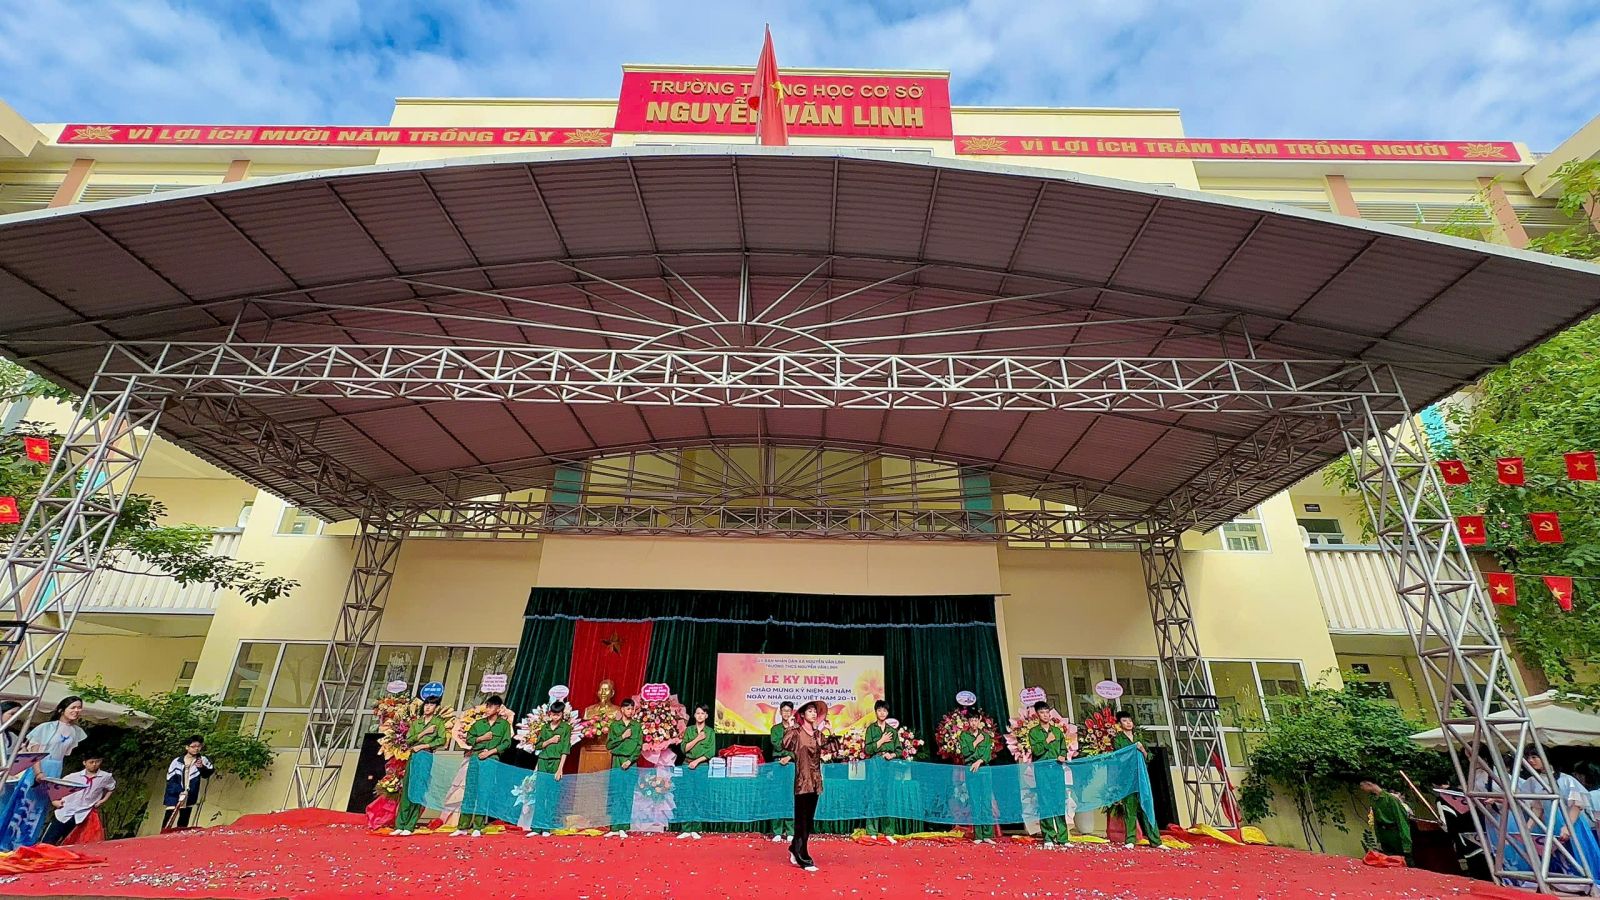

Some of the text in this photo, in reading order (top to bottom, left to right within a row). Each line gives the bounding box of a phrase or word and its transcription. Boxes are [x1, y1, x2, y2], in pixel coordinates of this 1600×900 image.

[651, 78, 924, 101] TRƯỜNG TNG HỌC CƠ SỞ
[783, 101, 843, 126] VĂN
[853, 105, 924, 128] LINH
[127, 126, 555, 142] VÌ LỢI ÍCH MƯỜI NĂM TRỒNG CÂY
[1019, 138, 1450, 156] VÌ LỢI ÍCH TRĂM NĂM TRỒNG NGƯỜI
[803, 673, 839, 687] NIỆM
